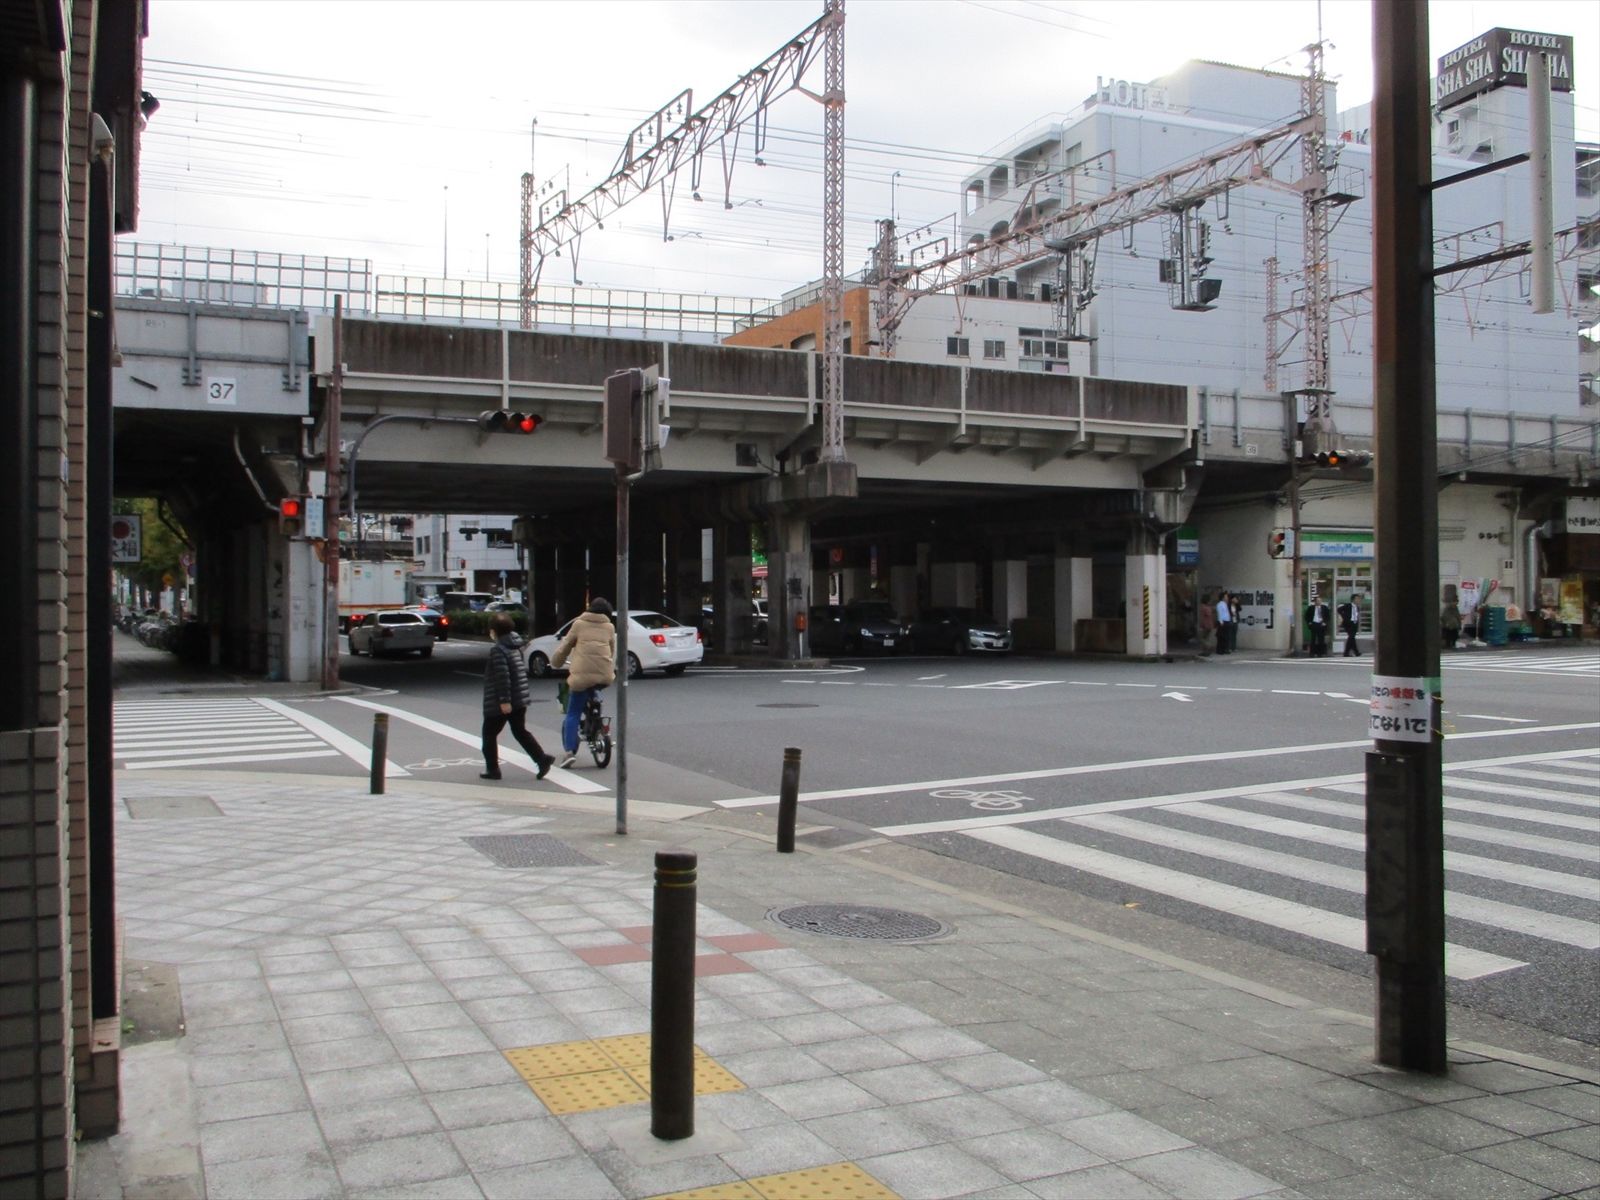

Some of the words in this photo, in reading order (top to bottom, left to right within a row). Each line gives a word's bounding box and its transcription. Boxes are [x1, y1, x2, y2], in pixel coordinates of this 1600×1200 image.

[1508, 31, 1561, 49] HOTEL
[1444, 38, 1487, 68] HOTEL
[1438, 67, 1463, 99] SHA
[1465, 51, 1493, 85] SHA
[1546, 54, 1569, 78] HA
[1097, 76, 1182, 112] HOTEL
[210, 382, 234, 399] 37
[1320, 543, 1364, 554] FamilyMart
[1370, 715, 1427, 733] てないで
